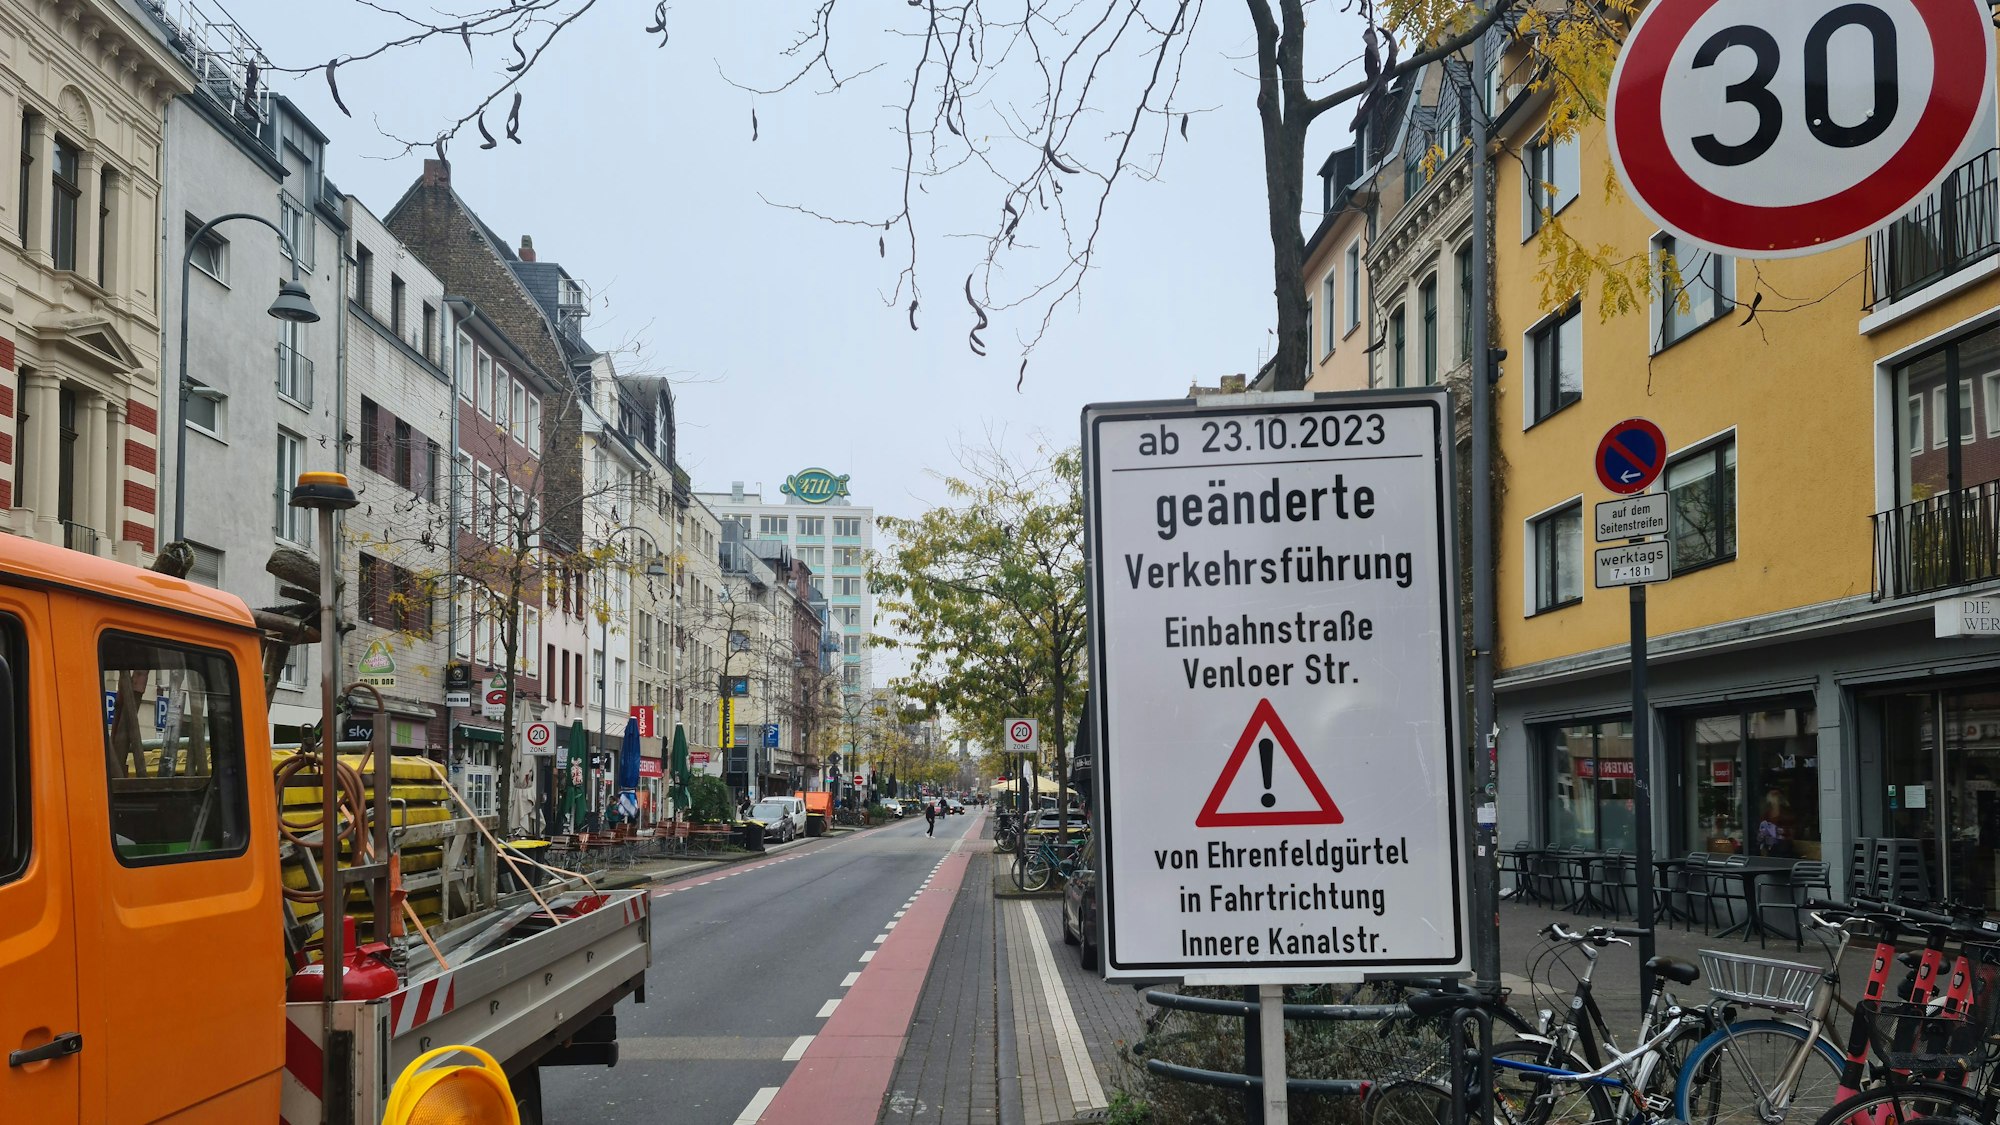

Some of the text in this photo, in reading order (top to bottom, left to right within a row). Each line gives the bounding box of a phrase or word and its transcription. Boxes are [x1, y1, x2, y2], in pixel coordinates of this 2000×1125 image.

[1691, 3, 1899, 167] 30
[1139, 413, 1386, 456] ab 23.10.2023
[1156, 474, 1375, 541] geänderte
[1612, 504, 1651, 518] auf dem
[1601, 516, 1664, 534] Seitenstreifen
[1125, 546, 1413, 590] Verkehrsführung
[1601, 551, 1663, 566] werktags
[1614, 568, 1620, 579] 7
[1629, 566, 1641, 577] 18
[1644, 565, 1651, 576] h
[1964, 601, 1991, 614] DIE
[1165, 610, 1373, 648] Einbahnstraße
[1183, 653, 1359, 689] Venloer Str.
[348, 725, 373, 740] sky
[532, 729, 546, 740] 20
[1015, 726, 1028, 737] 20
[1154, 837, 1409, 873] von Ehrenfeldgürtel
[1180, 883, 1385, 916] in Fahrtrichtung
[1181, 924, 1387, 957] Innere Kanalstr.
